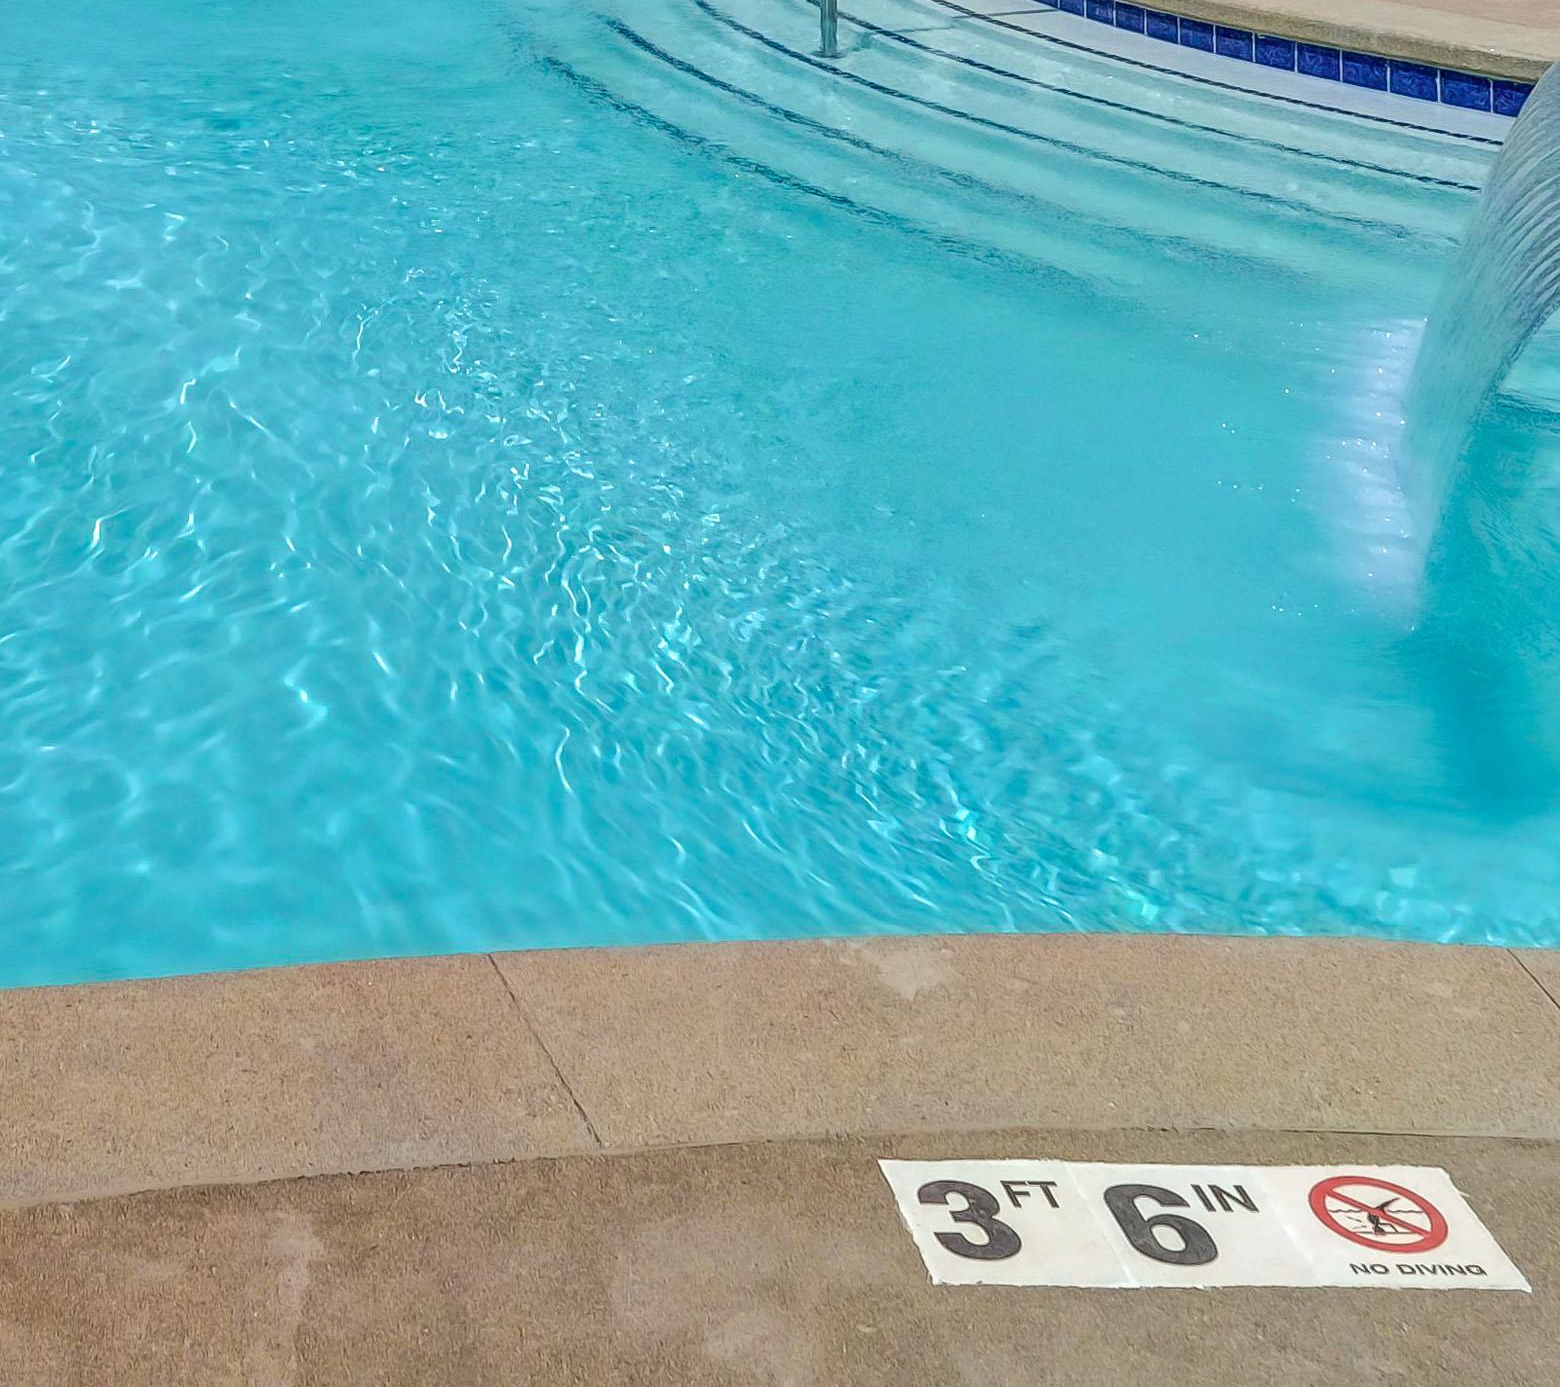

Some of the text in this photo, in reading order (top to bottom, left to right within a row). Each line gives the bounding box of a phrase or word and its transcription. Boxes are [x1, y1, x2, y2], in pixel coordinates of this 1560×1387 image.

[917, 1179, 1259, 1267] 3 FT 6 IN
[1349, 1263, 1488, 1277] NO DIVING
